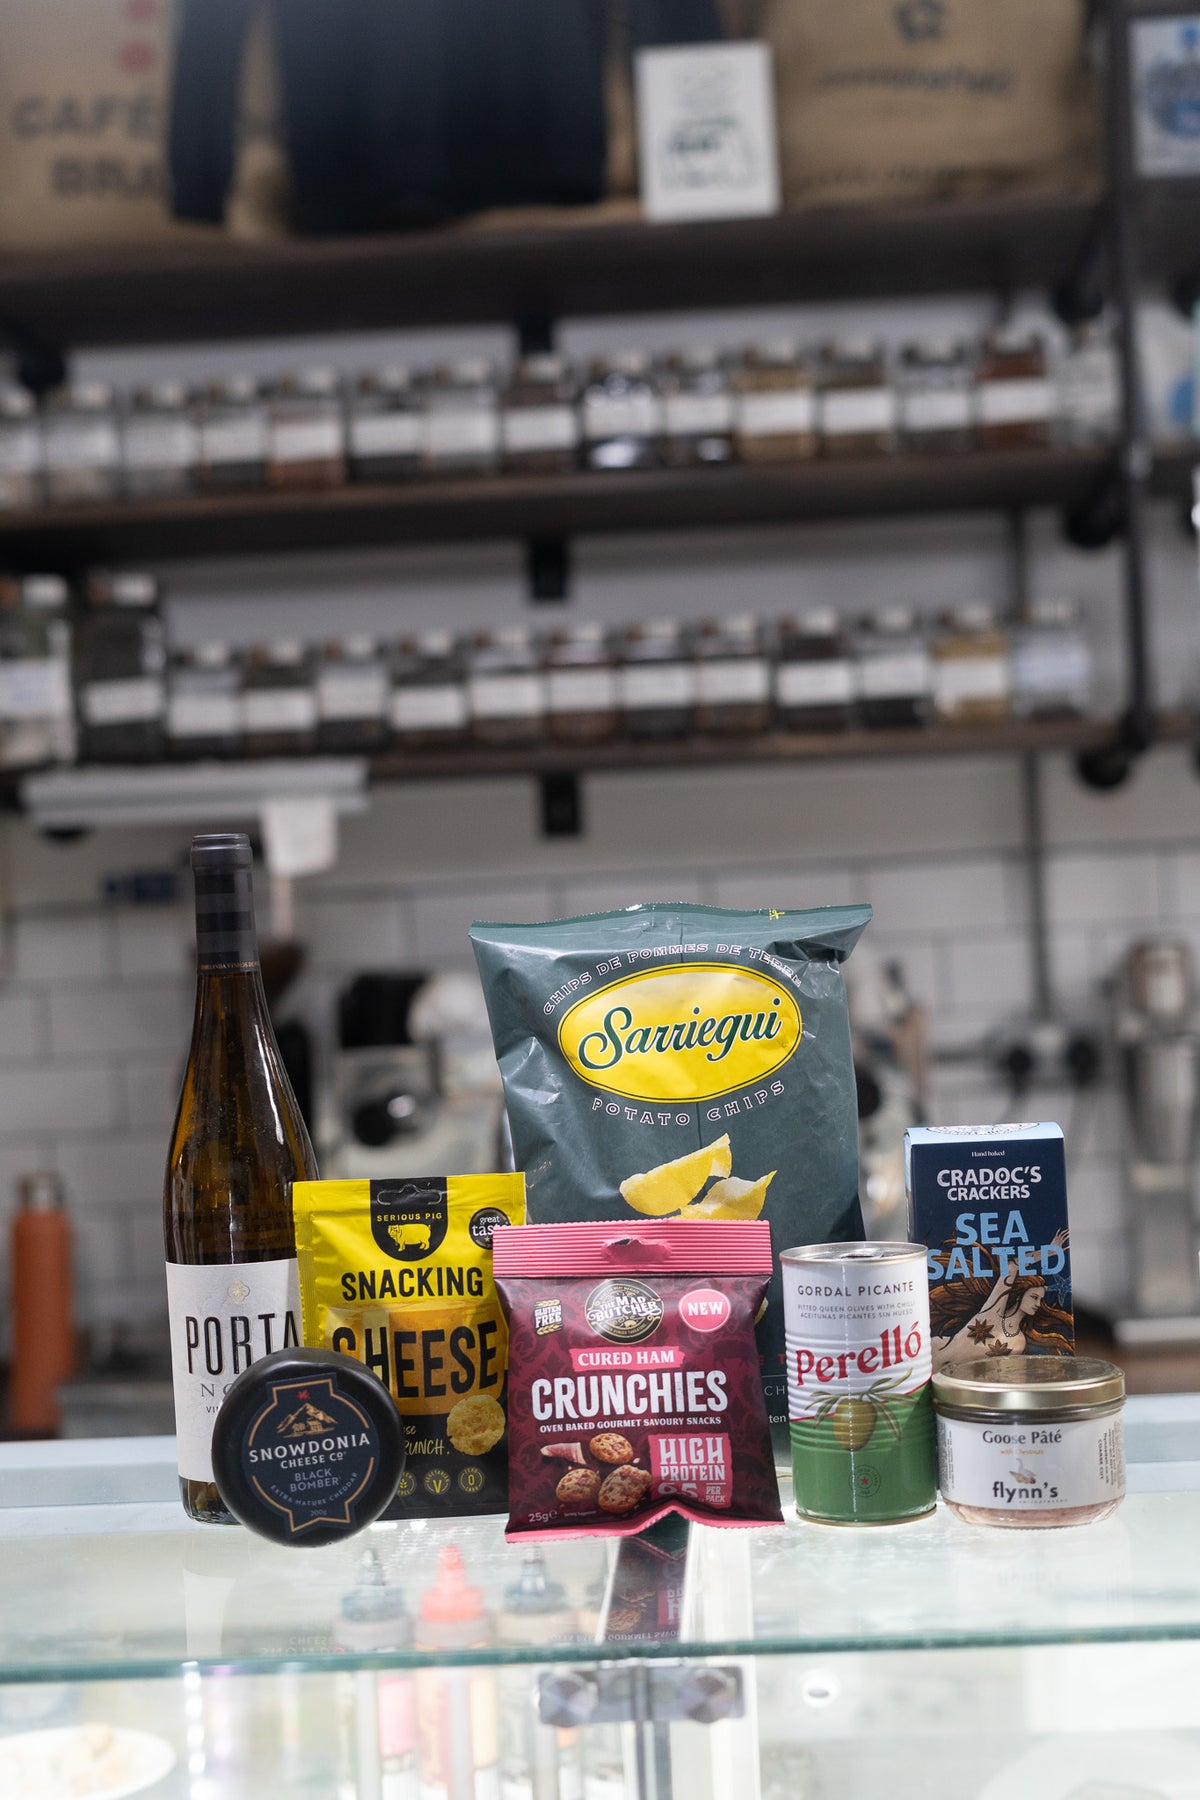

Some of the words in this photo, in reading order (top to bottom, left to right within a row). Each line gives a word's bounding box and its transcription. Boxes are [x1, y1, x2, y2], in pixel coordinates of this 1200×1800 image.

[543, 972, 592, 1015] CHIPS
[596, 959, 622, 976] DE
[628, 943, 709, 963] POMMES
[716, 944, 742, 956] DE
[749, 947, 802, 988] TERRE
[578, 997, 783, 1071] Sarriegui
[592, 1098, 690, 1126] POTATO
[707, 1080, 785, 1122] CHIPS
[937, 1166, 1042, 1187] CRADOC'S
[947, 1184, 1030, 1201] CRACKERS
[377, 1213, 421, 1222] SERIOUS
[425, 1212, 442, 1220] PIG
[479, 1215, 500, 1225] great
[472, 1223, 510, 1236] tas
[955, 1210, 1030, 1246] SEA
[927, 1244, 1066, 1281] SALTED
[341, 1266, 484, 1301] SNACKING
[798, 1285, 852, 1297] GORDAL
[858, 1281, 914, 1296] PICANTE
[534, 1304, 562, 1318] GLUTEN
[587, 1301, 662, 1321] BUTCHER
[600, 1301, 615, 1310] THE
[616, 1296, 646, 1306] MAD
[688, 1301, 724, 1316] NEW
[877, 1302, 895, 1310] WITH
[535, 1312, 562, 1328] FREE
[839, 1312, 876, 1320] PICANTES
[578, 1351, 633, 1366] CURED
[636, 1350, 675, 1365] HAM
[795, 1321, 921, 1386] Perelló
[531, 1370, 728, 1421] CRUNCHIES
[540, 1424, 563, 1433] OVEN
[565, 1421, 595, 1432] BAKED
[597, 1419, 641, 1429] GOURMET
[643, 1417, 684, 1427] SAVOURY
[686, 1416, 722, 1426] SNACKS
[982, 1430, 1026, 1445] Goose
[1031, 1429, 1062, 1445] Pâté
[249, 1432, 370, 1463] SNOWDONIA
[658, 1437, 725, 1465] HIGH
[280, 1454, 325, 1470] CHEESE
[294, 1468, 332, 1482] BLACK
[660, 1465, 725, 1481] PROTEIN
[270, 1484, 293, 1503] EXTRA
[295, 1498, 327, 1506] MATURE
[329, 1472, 359, 1501] CHEDDAR
[289, 1478, 339, 1493] BOMBER
[433, 1479, 442, 1494] V
[705, 1486, 721, 1495] PER
[992, 1481, 1059, 1503] flynn's
[705, 1495, 725, 1503] PACK
